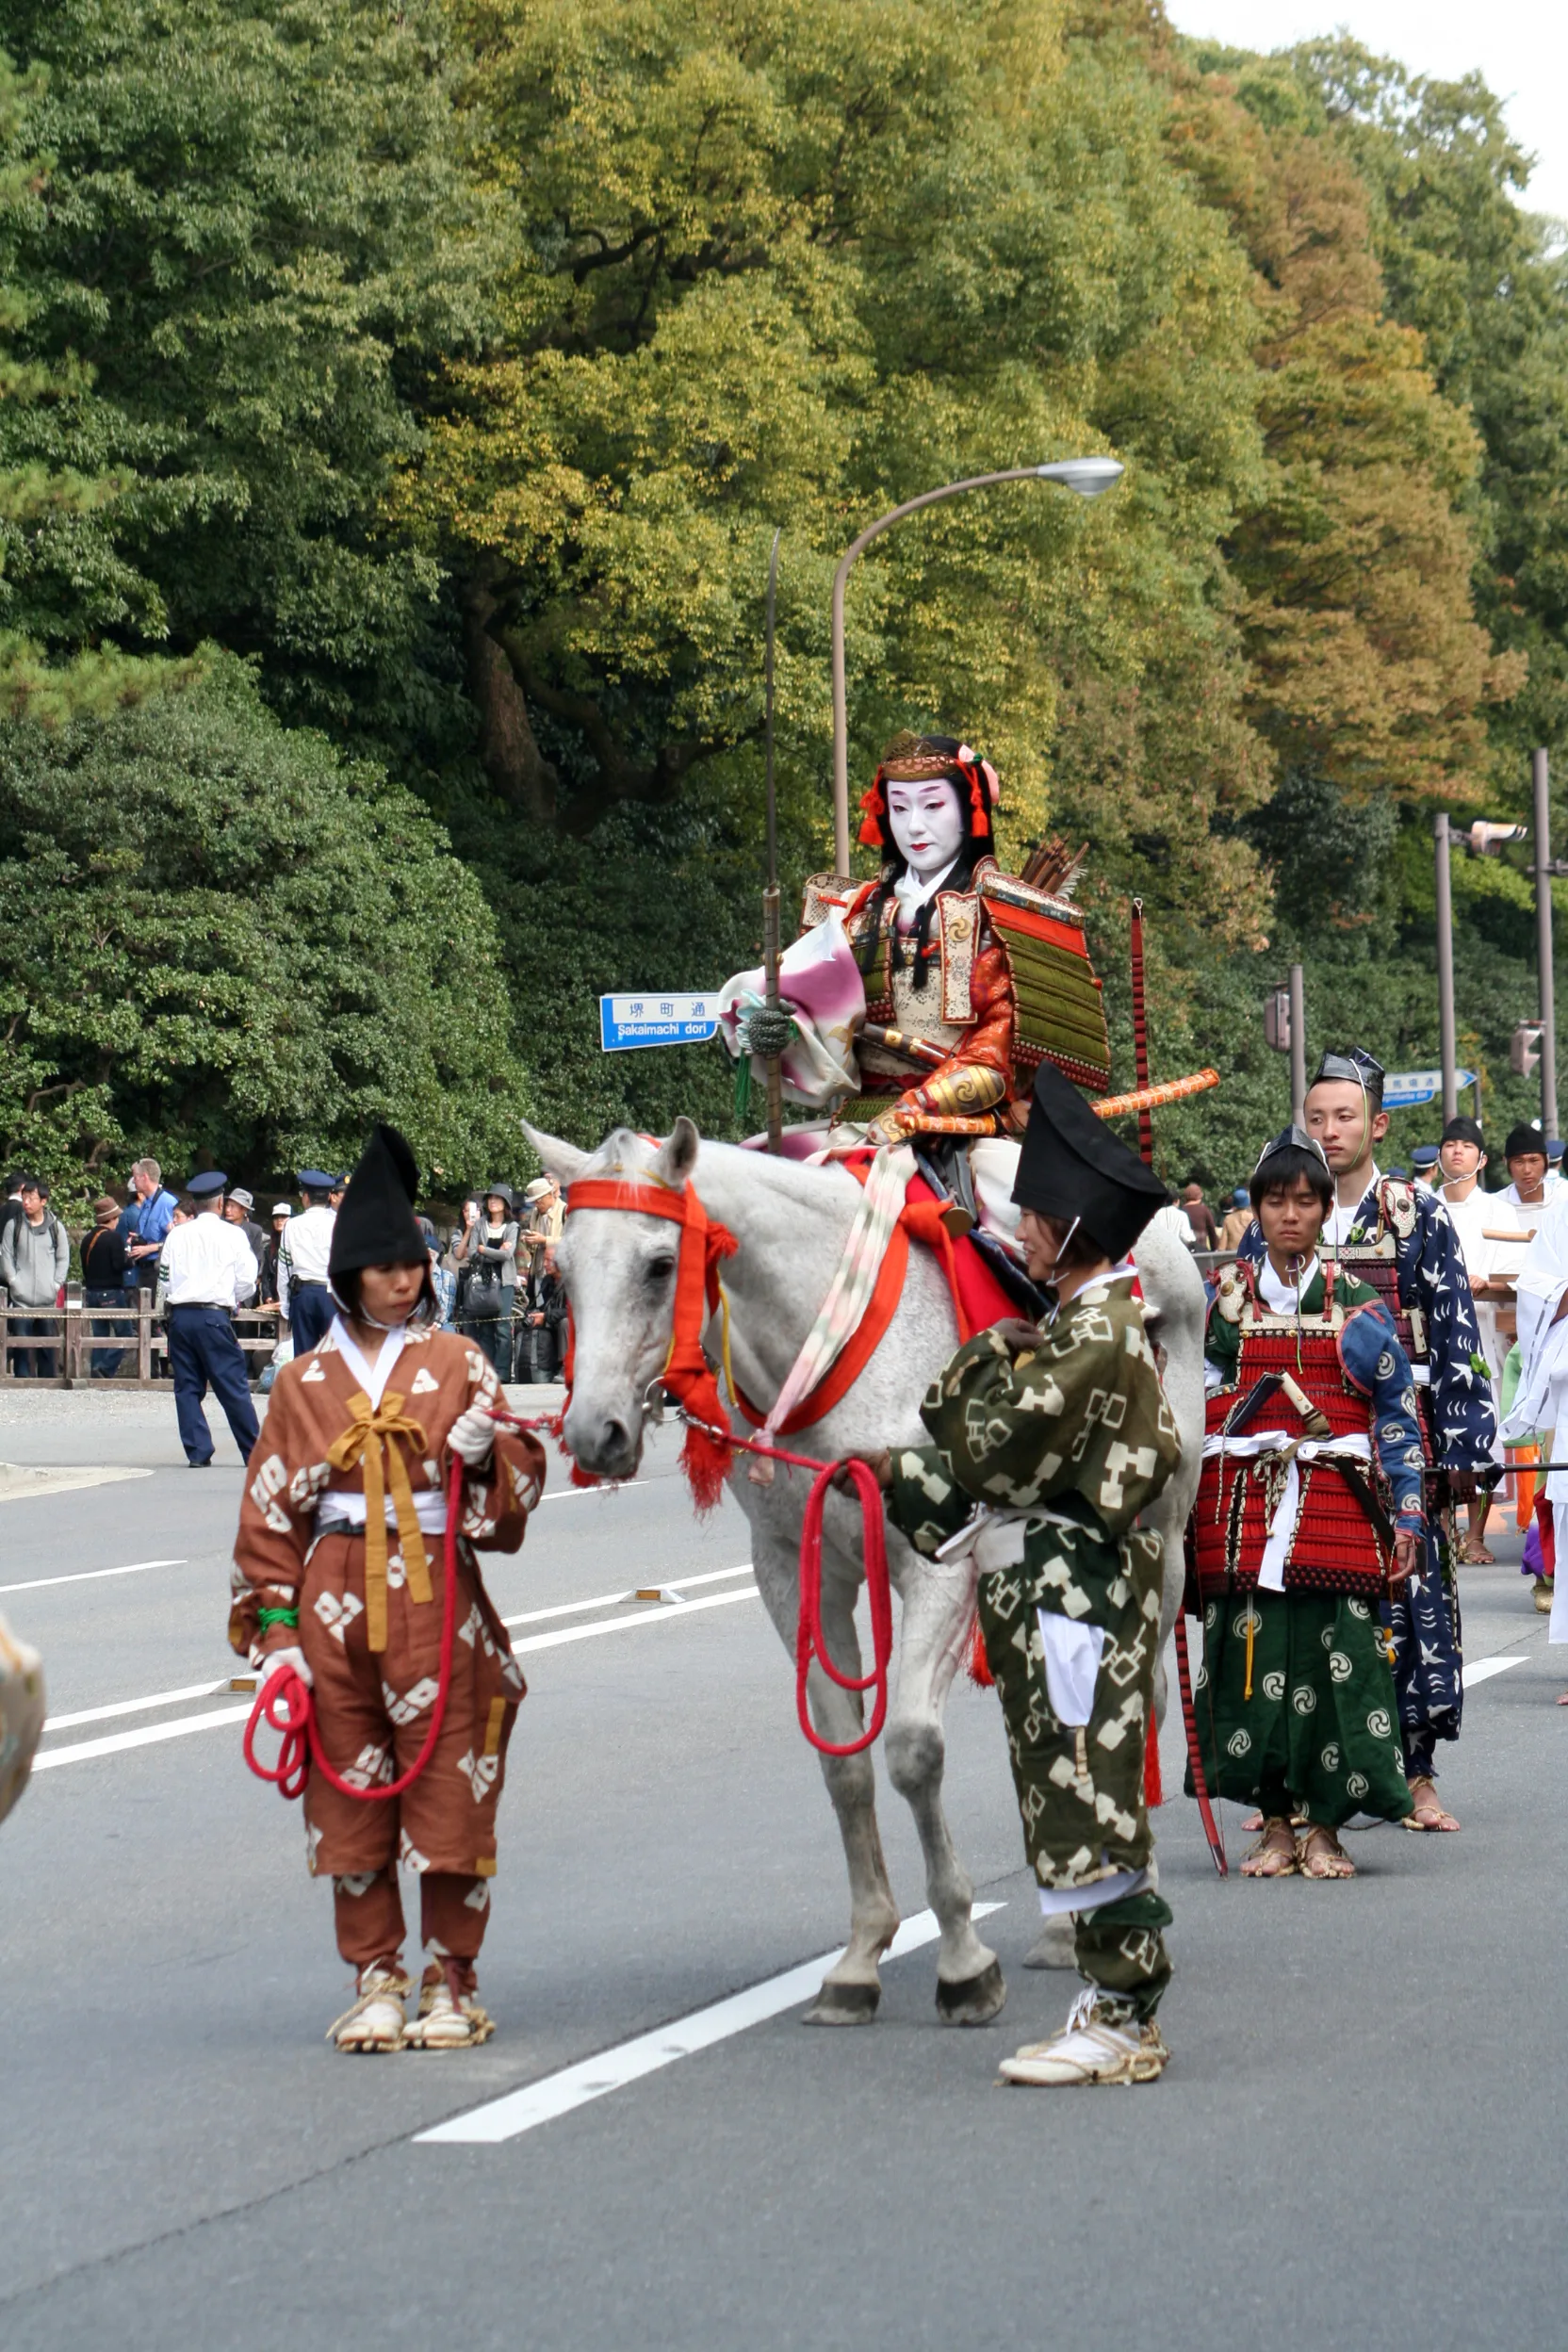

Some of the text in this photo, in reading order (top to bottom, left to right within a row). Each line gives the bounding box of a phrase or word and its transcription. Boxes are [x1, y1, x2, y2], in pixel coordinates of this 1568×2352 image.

[629, 1002, 706, 1018] 堺町通
[618, 1023, 706, 1036] Sakaimachi dori
